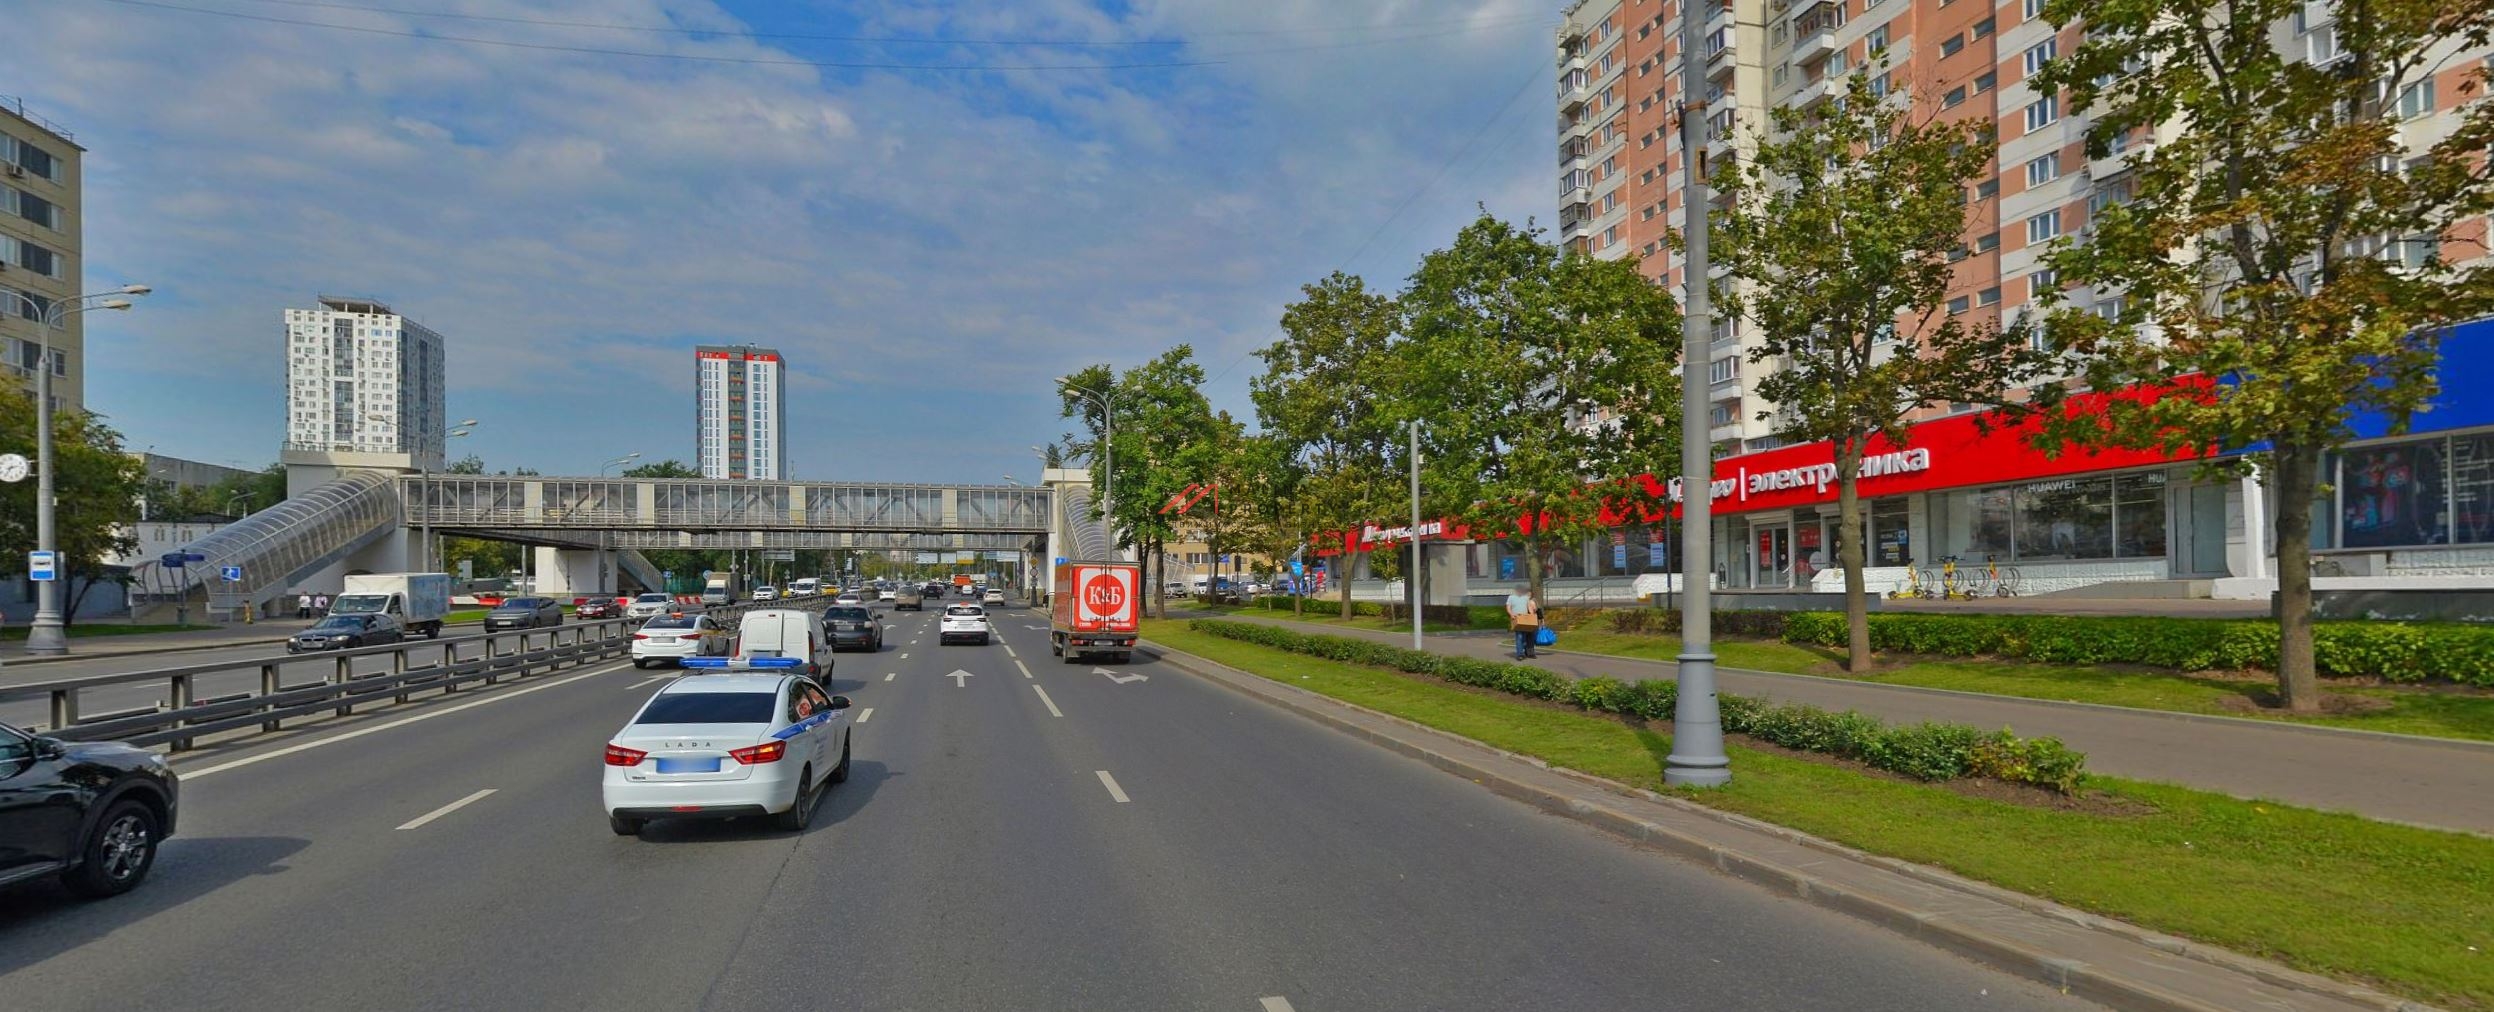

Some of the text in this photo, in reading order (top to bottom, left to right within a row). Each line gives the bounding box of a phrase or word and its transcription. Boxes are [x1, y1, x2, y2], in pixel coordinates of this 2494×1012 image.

[1749, 447, 1930, 494] электрника
[2027, 479, 2076, 493] HUAWEI
[1089, 586, 1121, 605] К&Б
